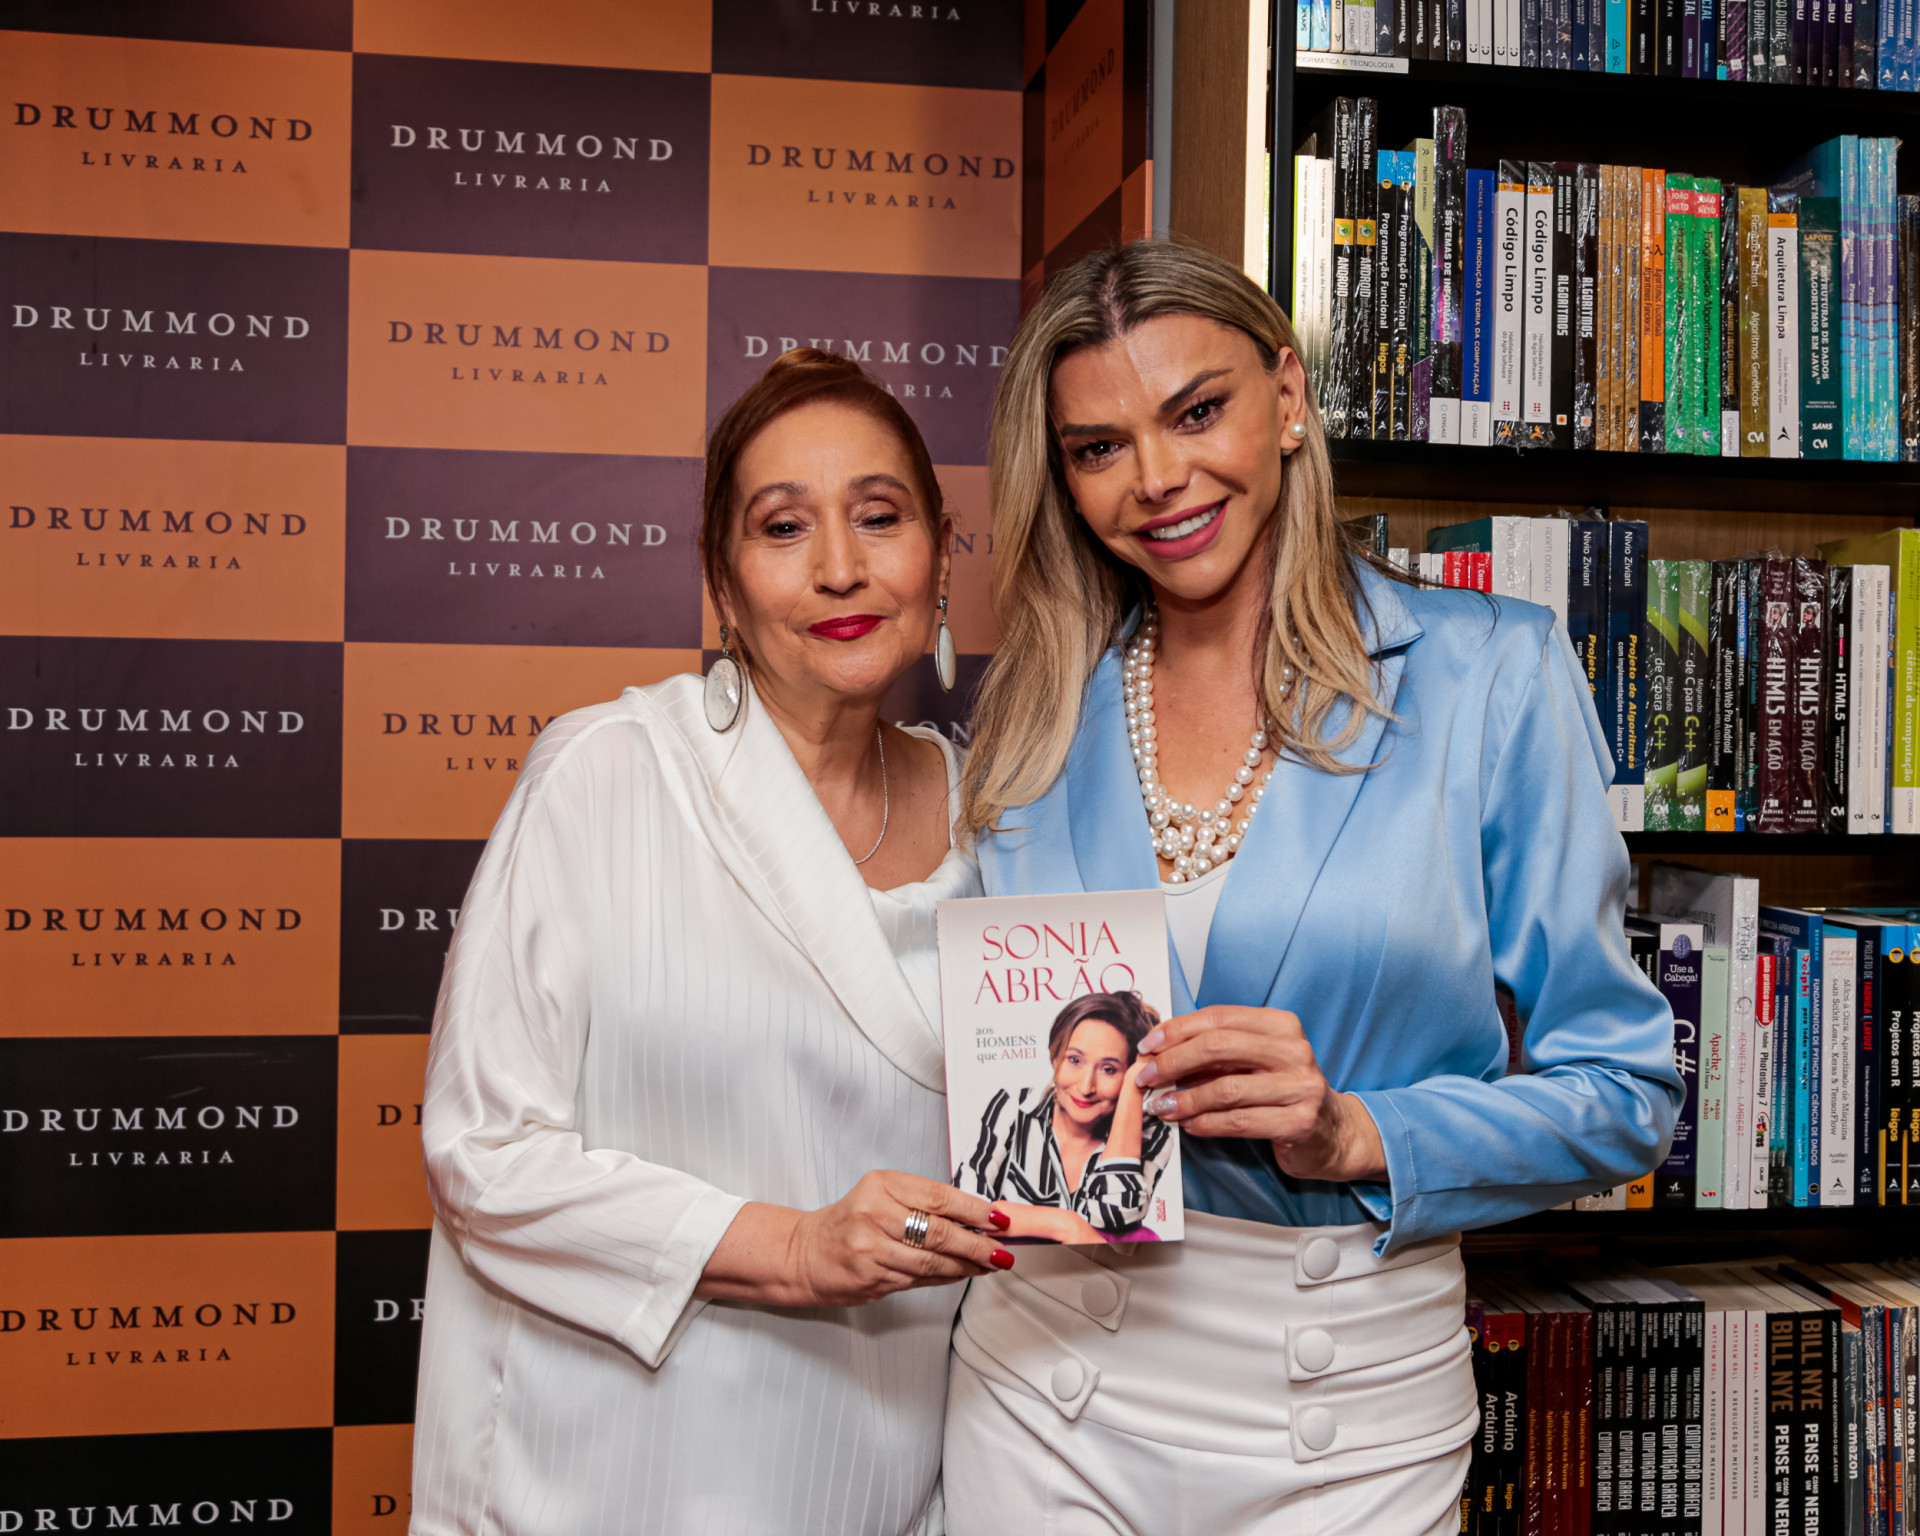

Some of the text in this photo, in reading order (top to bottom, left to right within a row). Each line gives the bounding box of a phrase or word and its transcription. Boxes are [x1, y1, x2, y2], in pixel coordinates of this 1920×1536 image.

[810, 0, 961, 21] LIVRARIA
[1350, 60, 1395, 69] TECNOLOGIA
[15, 102, 313, 142] DRUMMOND
[82, 151, 248, 173] LIVRARIA
[391, 125, 673, 161] DRUMMOND
[747, 143, 1016, 179] DRUMMOND
[455, 172, 611, 192] LIVRARIA
[808, 190, 957, 210] LIVRARIA
[1443, 210, 1453, 260] SISTEMAS
[1750, 214, 1760, 287] Ricardo Linden
[1337, 256, 1349, 297] ANDROID
[1360, 257, 1372, 297] ANDROID
[1378, 212, 1391, 328] Programação Funcional
[1398, 214, 1410, 330] Programação Funcional
[1443, 262, 1452, 276] DE
[1503, 207, 1519, 312] Código Limpo
[1532, 210, 1548, 314] Código Limpo
[1556, 274, 1569, 336] ALGORITMOS
[1581, 277, 1594, 338] ALGORITMOS
[1702, 231, 1714, 351] Programação Algoritmos
[1774, 236, 1787, 339] Arquitetura Limpa
[12, 305, 310, 339] DRUMMOND
[1471, 237, 1484, 394] INTRODUÇÃO TEORIA DA COMPUTAÇÃO
[1810, 269, 1819, 350] ALGORITMOS EM
[1820, 265, 1830, 380] ESTRUTURAS DE DADOS
[388, 321, 670, 353] DRUMMOND
[80, 352, 244, 372] LIVRARIA
[451, 366, 609, 386] LIVRARIA
[1378, 342, 1390, 374] leigos
[1396, 343, 1408, 375] leigos
[1750, 311, 1762, 407] Algoritmos Genéticos
[9, 506, 307, 536] DRUMMOND
[385, 517, 668, 546] DRUMMOND
[77, 553, 242, 570] LIVRARIA
[449, 561, 606, 580] LIVRARIA
[1583, 531, 1592, 586] Nivio Ziviani
[1624, 531, 1633, 586] Nivio Ziviani
[1586, 634, 1598, 680] Projeto
[1616, 658, 1624, 712] implementações
[1626, 634, 1638, 770] Projeto de Algoritmos
[1652, 658, 1669, 750] de para C++
[1665, 676, 1674, 711] Migrando
[1694, 678, 1704, 713] Migrando
[1722, 650, 1735, 753] Aplicativos Web Pro Android
[1834, 672, 1846, 720] HTML5
[7, 708, 305, 733] DRUMMOND
[1682, 660, 1699, 752] de para C++
[1766, 658, 1786, 770] HTML5 EM AÇÃO
[1798, 658, 1820, 770] HTML5 EM AÇÃO
[1902, 650, 1916, 782] ciência da computação
[74, 753, 240, 769] LIVRARIA
[447, 757, 518, 771] LIVR
[4, 908, 302, 932] DRUMMOND
[982, 920, 1122, 961] SONIA
[72, 953, 237, 967] LIVRARIA
[1664, 973, 1698, 983] Cabeça!
[1669, 964, 1687, 973] Use
[974, 958, 1135, 1005] ABRÃO
[1863, 940, 1874, 1050] PROJETO FÁBRICA LAYOUT
[975, 1027, 994, 1036] aos
[976, 1035, 1037, 1049] HOMENS
[1709, 1032, 1722, 1070] Apache
[1890, 1010, 1902, 1087] Projetos em R
[976, 1047, 1037, 1064] que AMEI
[1758, 1052, 1769, 1098] Photoshop
[1810, 978, 1820, 1166] FUNDAMENTOS PYTHON CIÊNCIA DADOS
[1736, 1032, 1747, 1137] KENNETH LAMBERT
[2, 1105, 299, 1132] DRUMMOND
[1888, 1108, 1901, 1142] leigos
[69, 1149, 235, 1167] LIVRARIA
[0, 1302, 296, 1332] DRUMMOND
[66, 1347, 231, 1366] LIVRARIA
[1771, 1320, 1794, 1413] BILL NYE
[1800, 1319, 1823, 1411] BILL NYE
[1484, 1392, 1498, 1454] Arduino
[1502, 1391, 1518, 1452] Arduino
[1906, 1375, 1916, 1436] Steve Jobs
[1775, 1424, 1790, 1475] PENSE
[1804, 1423, 1819, 1474] PENSE
[1848, 1422, 1859, 1480] amazon
[1596, 1432, 1613, 1512] COMPUTAÇÃO GRÁFICA
[1618, 1430, 1634, 1510] COMPUTAÇÃO GRÁFICA
[1640, 1432, 1657, 1512] COMPUTAÇÃO GRÁFICA
[1660, 1424, 1680, 1518] COMPUTAÇÃO GRÁFICA
[1682, 1424, 1702, 1518] COMPUTAÇÃO GRÁFICA
[1776, 1482, 1782, 1492] UM
[1805, 1480, 1812, 1490] UM
[0, 1499, 293, 1533] DRUMMOND
[1484, 1485, 1495, 1512] leigos
[1504, 1483, 1515, 1510] leigos
[1774, 1498, 1790, 1536] NERD
[1804, 1496, 1819, 1536] NERD
